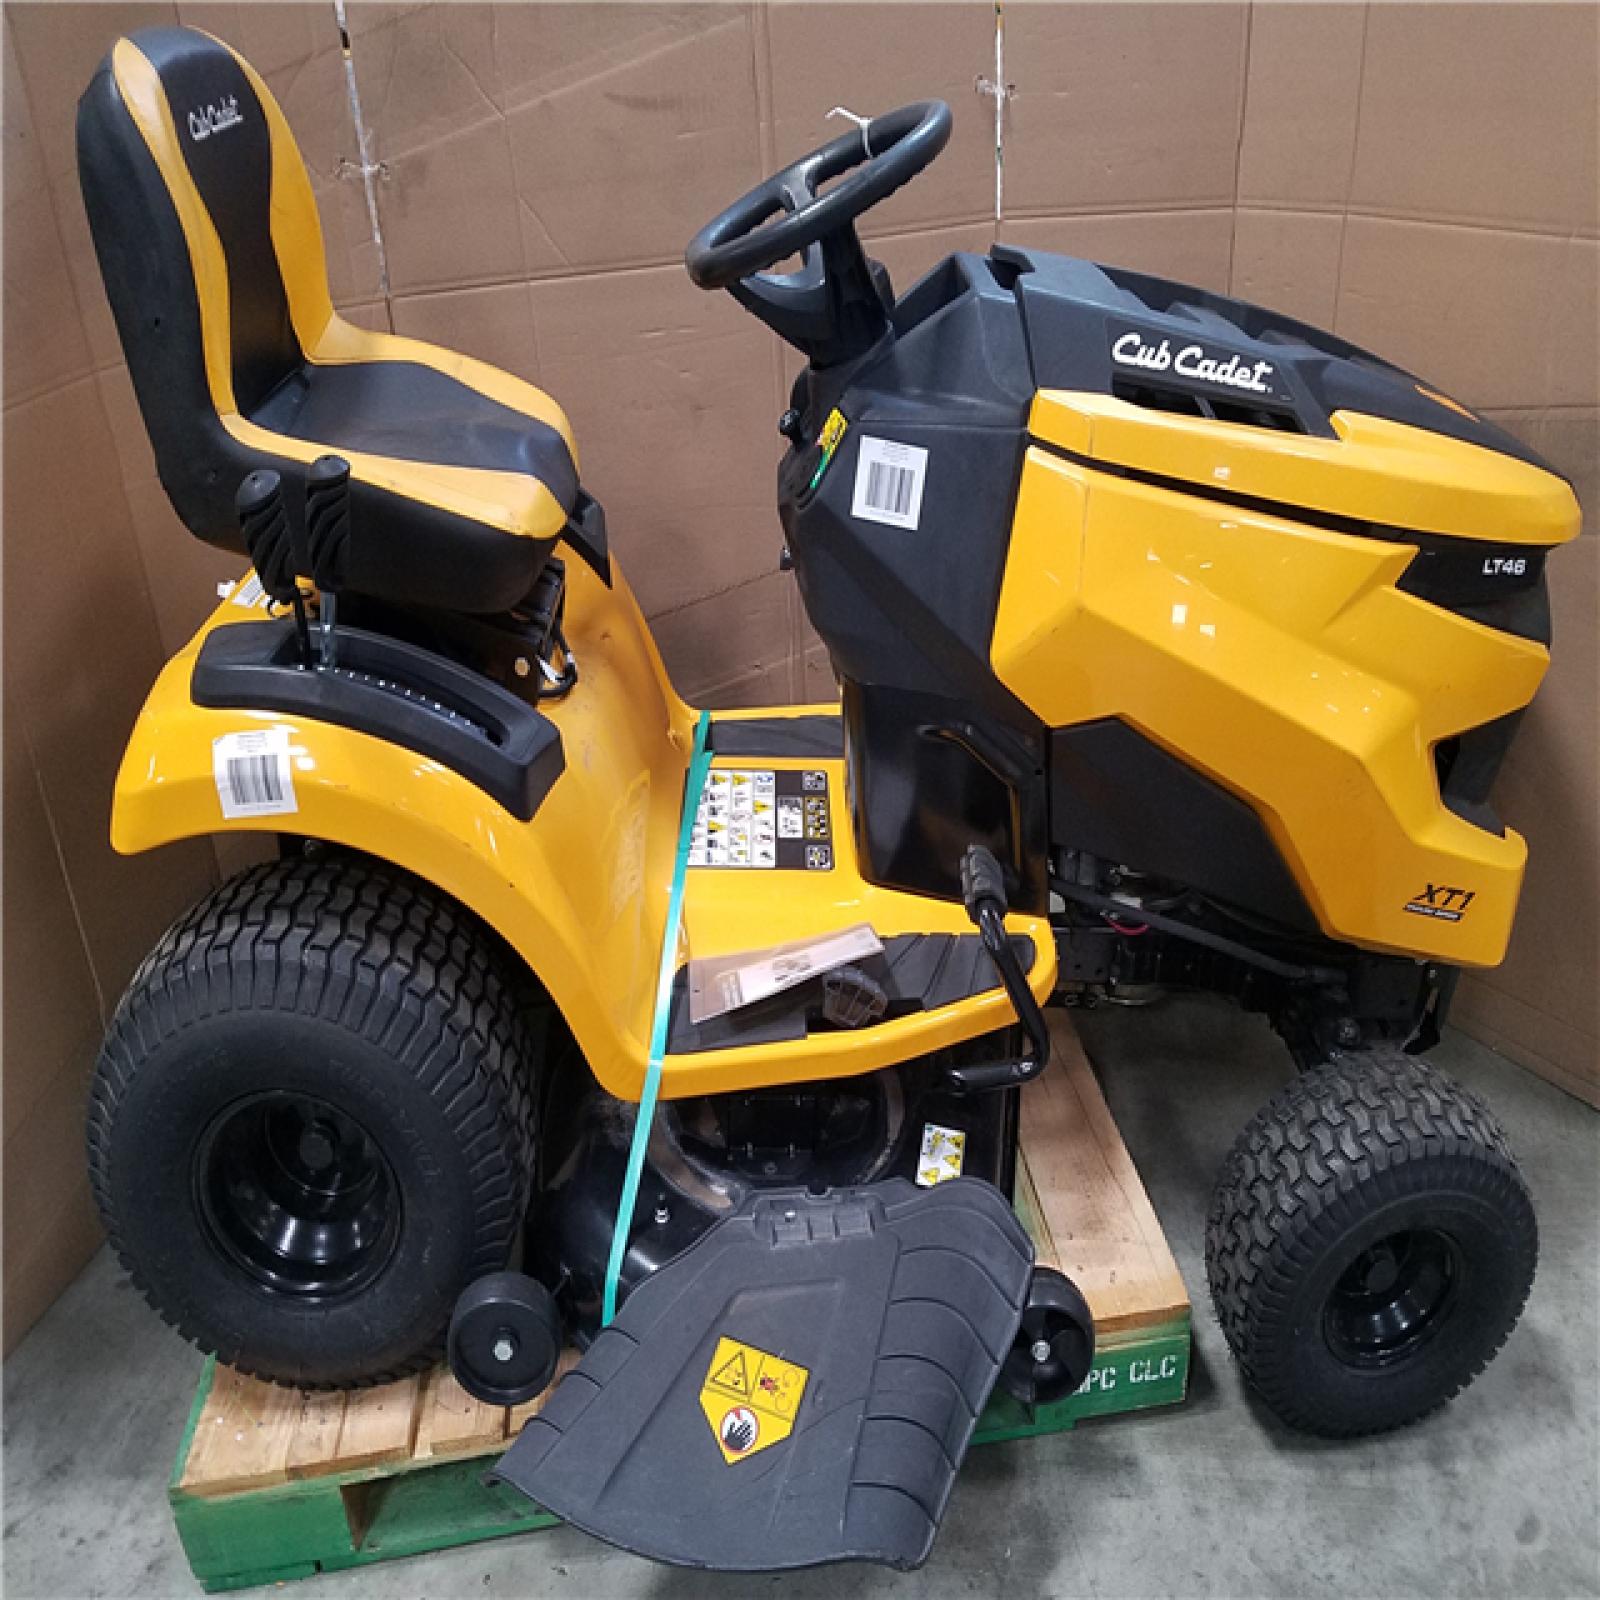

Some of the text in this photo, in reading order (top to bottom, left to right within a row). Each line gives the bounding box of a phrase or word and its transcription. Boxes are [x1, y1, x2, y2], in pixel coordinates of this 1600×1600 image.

[1112, 333, 1273, 392] Cub Cadet
[1412, 884, 1475, 910] XT1
[1129, 1355, 1176, 1383] CLC
